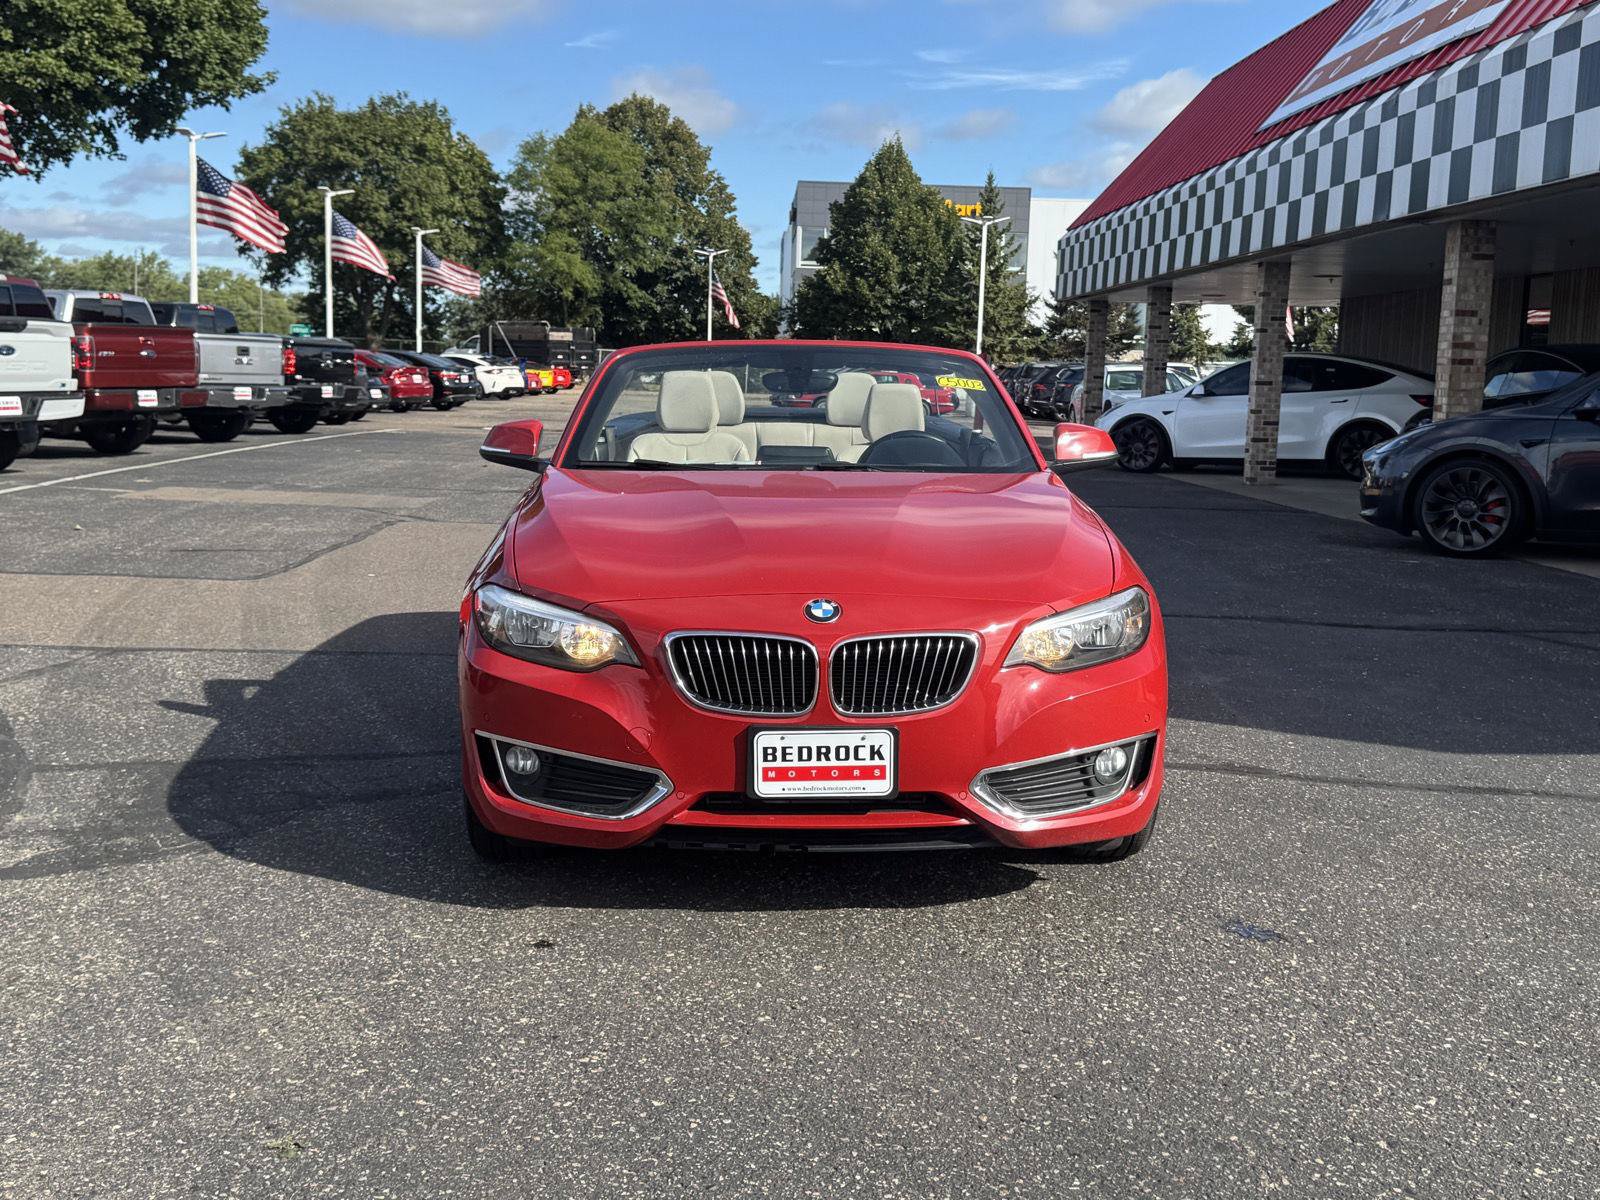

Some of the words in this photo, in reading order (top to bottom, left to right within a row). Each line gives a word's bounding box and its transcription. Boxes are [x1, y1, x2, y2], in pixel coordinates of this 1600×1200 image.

[762, 744, 886, 763] BEDROCK
[767, 769, 881, 778] MOTORS
[787, 785, 862, 793] www.bedrockmotors.com
